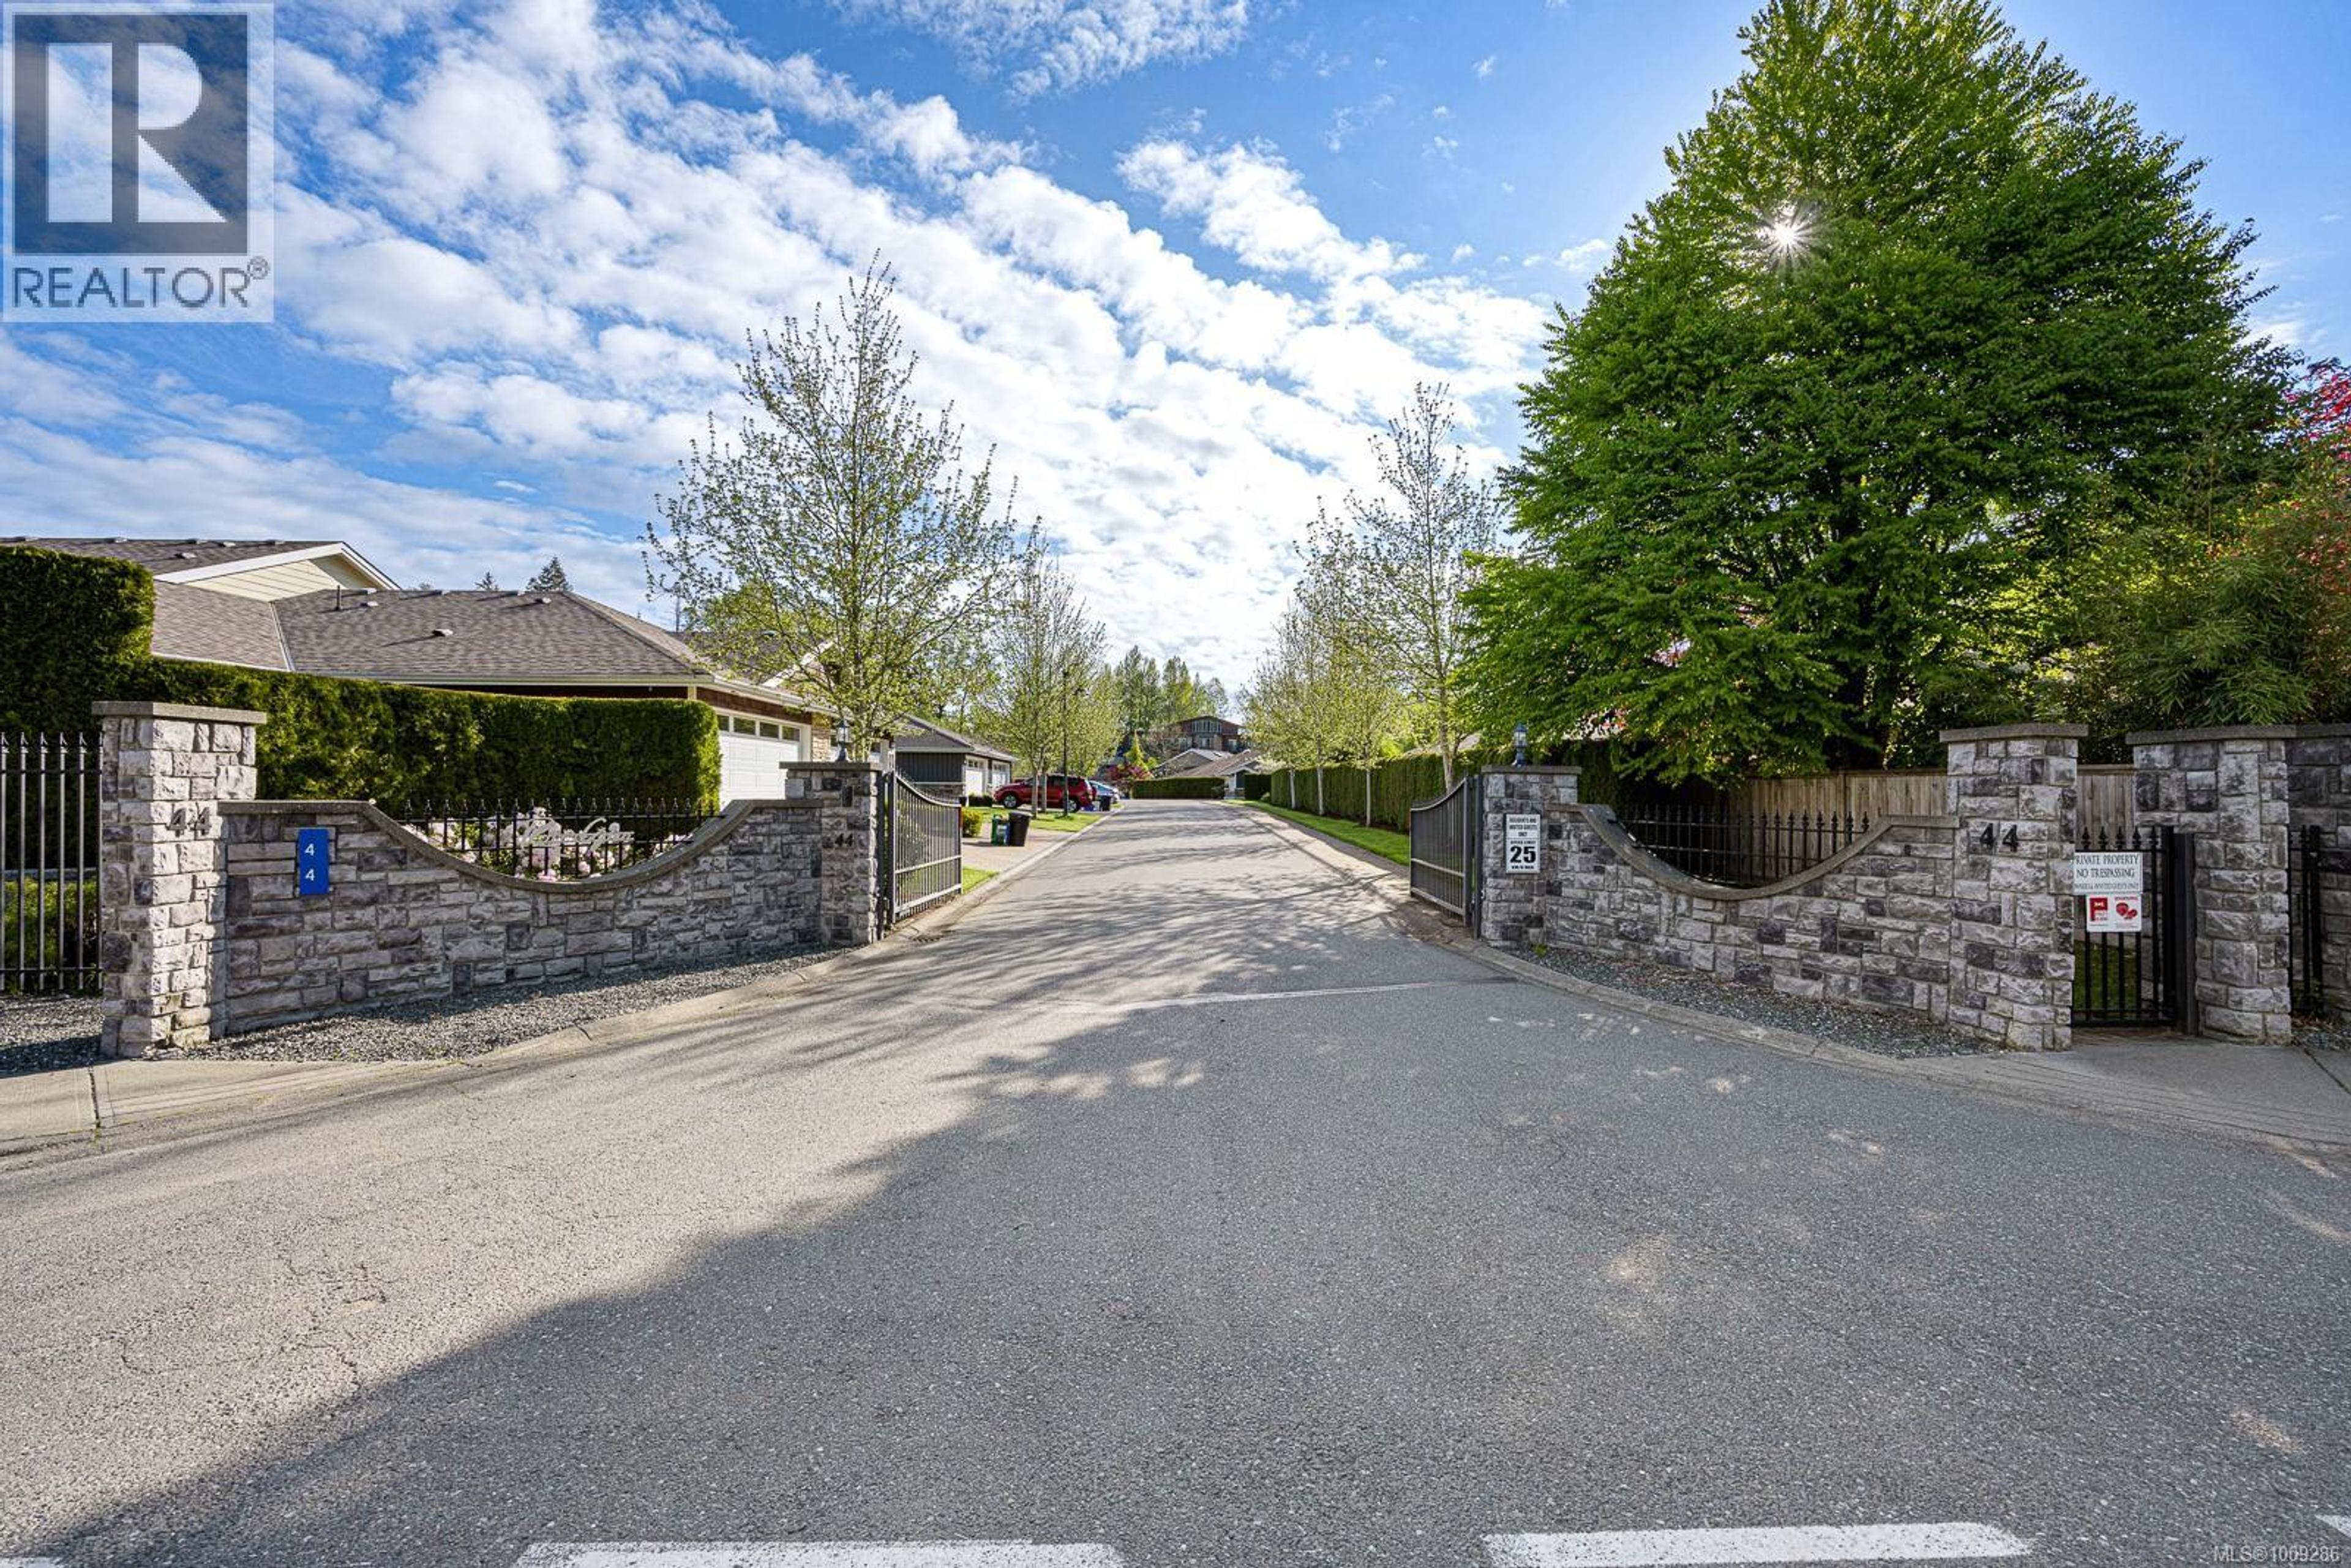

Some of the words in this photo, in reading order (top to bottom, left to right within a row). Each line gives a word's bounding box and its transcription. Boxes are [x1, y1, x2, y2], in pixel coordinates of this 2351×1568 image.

[167, 807, 212, 837] 44
[834, 833, 854, 847] 44
[1979, 823, 2019, 852] 44
[304, 844, 315, 856] 4
[1510, 846, 1536, 863] 25
[2075, 855, 2100, 865] RIVATE
[2102, 854, 2139, 865] PROPERTY
[305, 868, 315, 881] 4
[2077, 868, 2089, 878] NO
[2090, 868, 2135, 879] TRESPASSING
